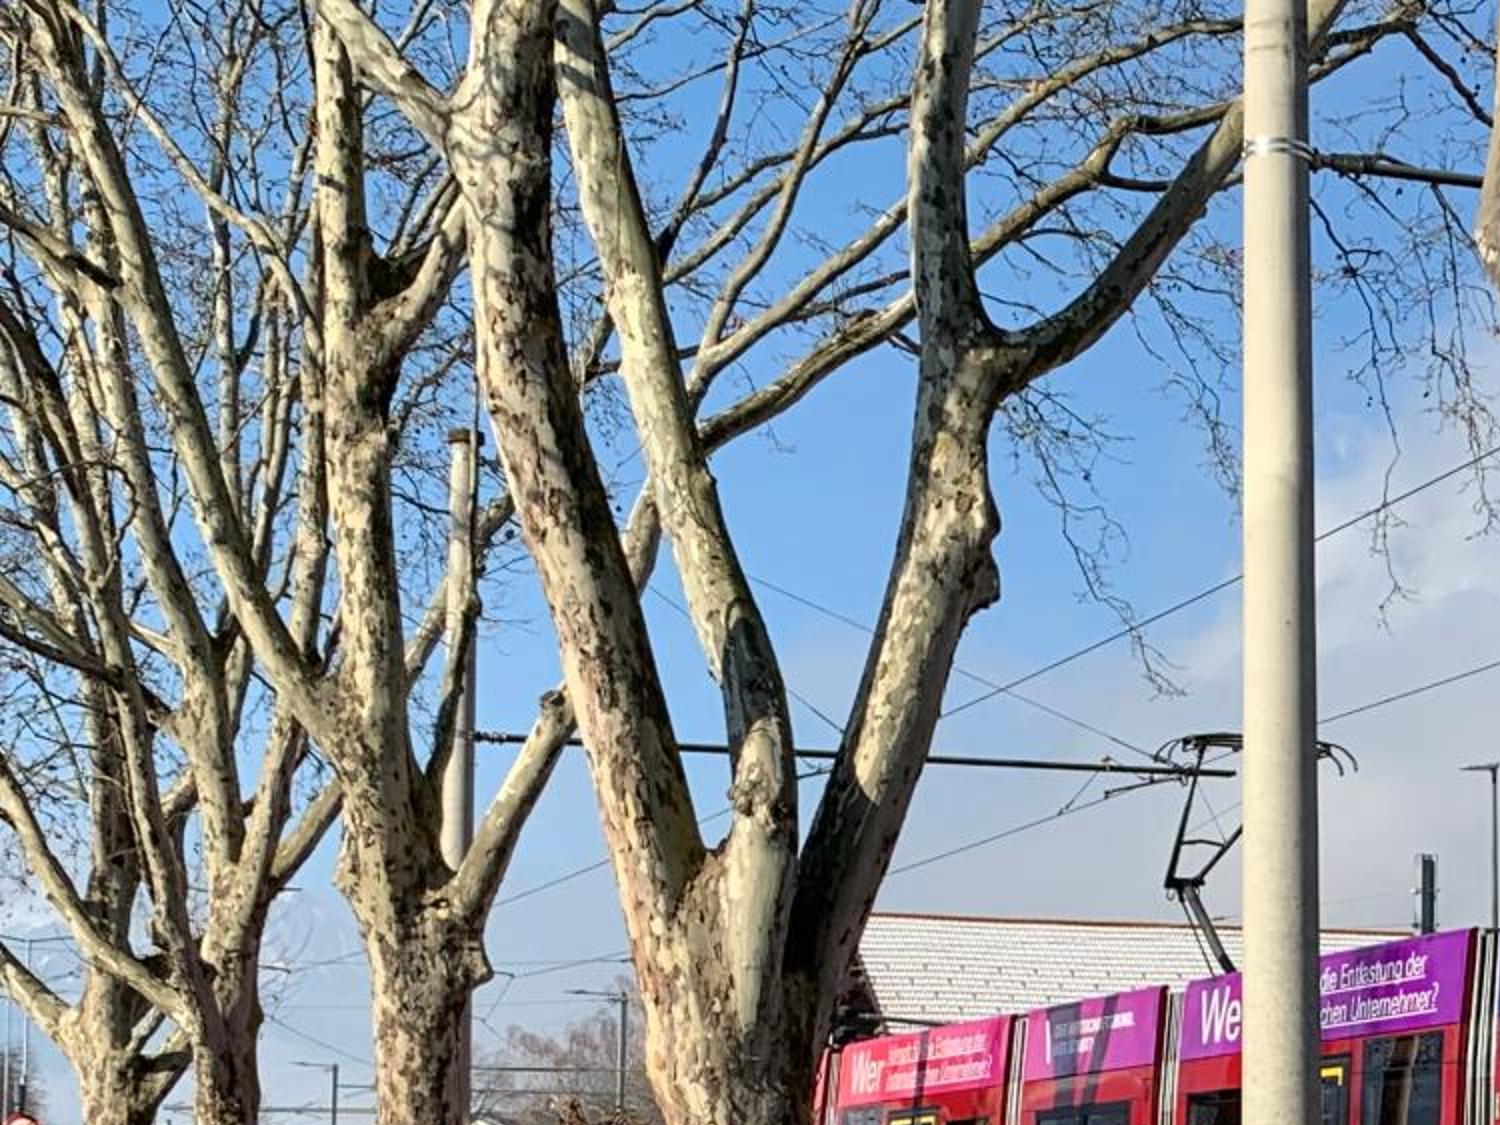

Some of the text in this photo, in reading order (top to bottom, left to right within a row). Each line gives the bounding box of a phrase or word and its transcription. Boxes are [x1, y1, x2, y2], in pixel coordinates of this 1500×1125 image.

[1405, 951, 1429, 977] der
[1201, 984, 1242, 1046] We
[1349, 981, 1440, 1021] Unternehmer?
[851, 1050, 886, 1095] Wer
